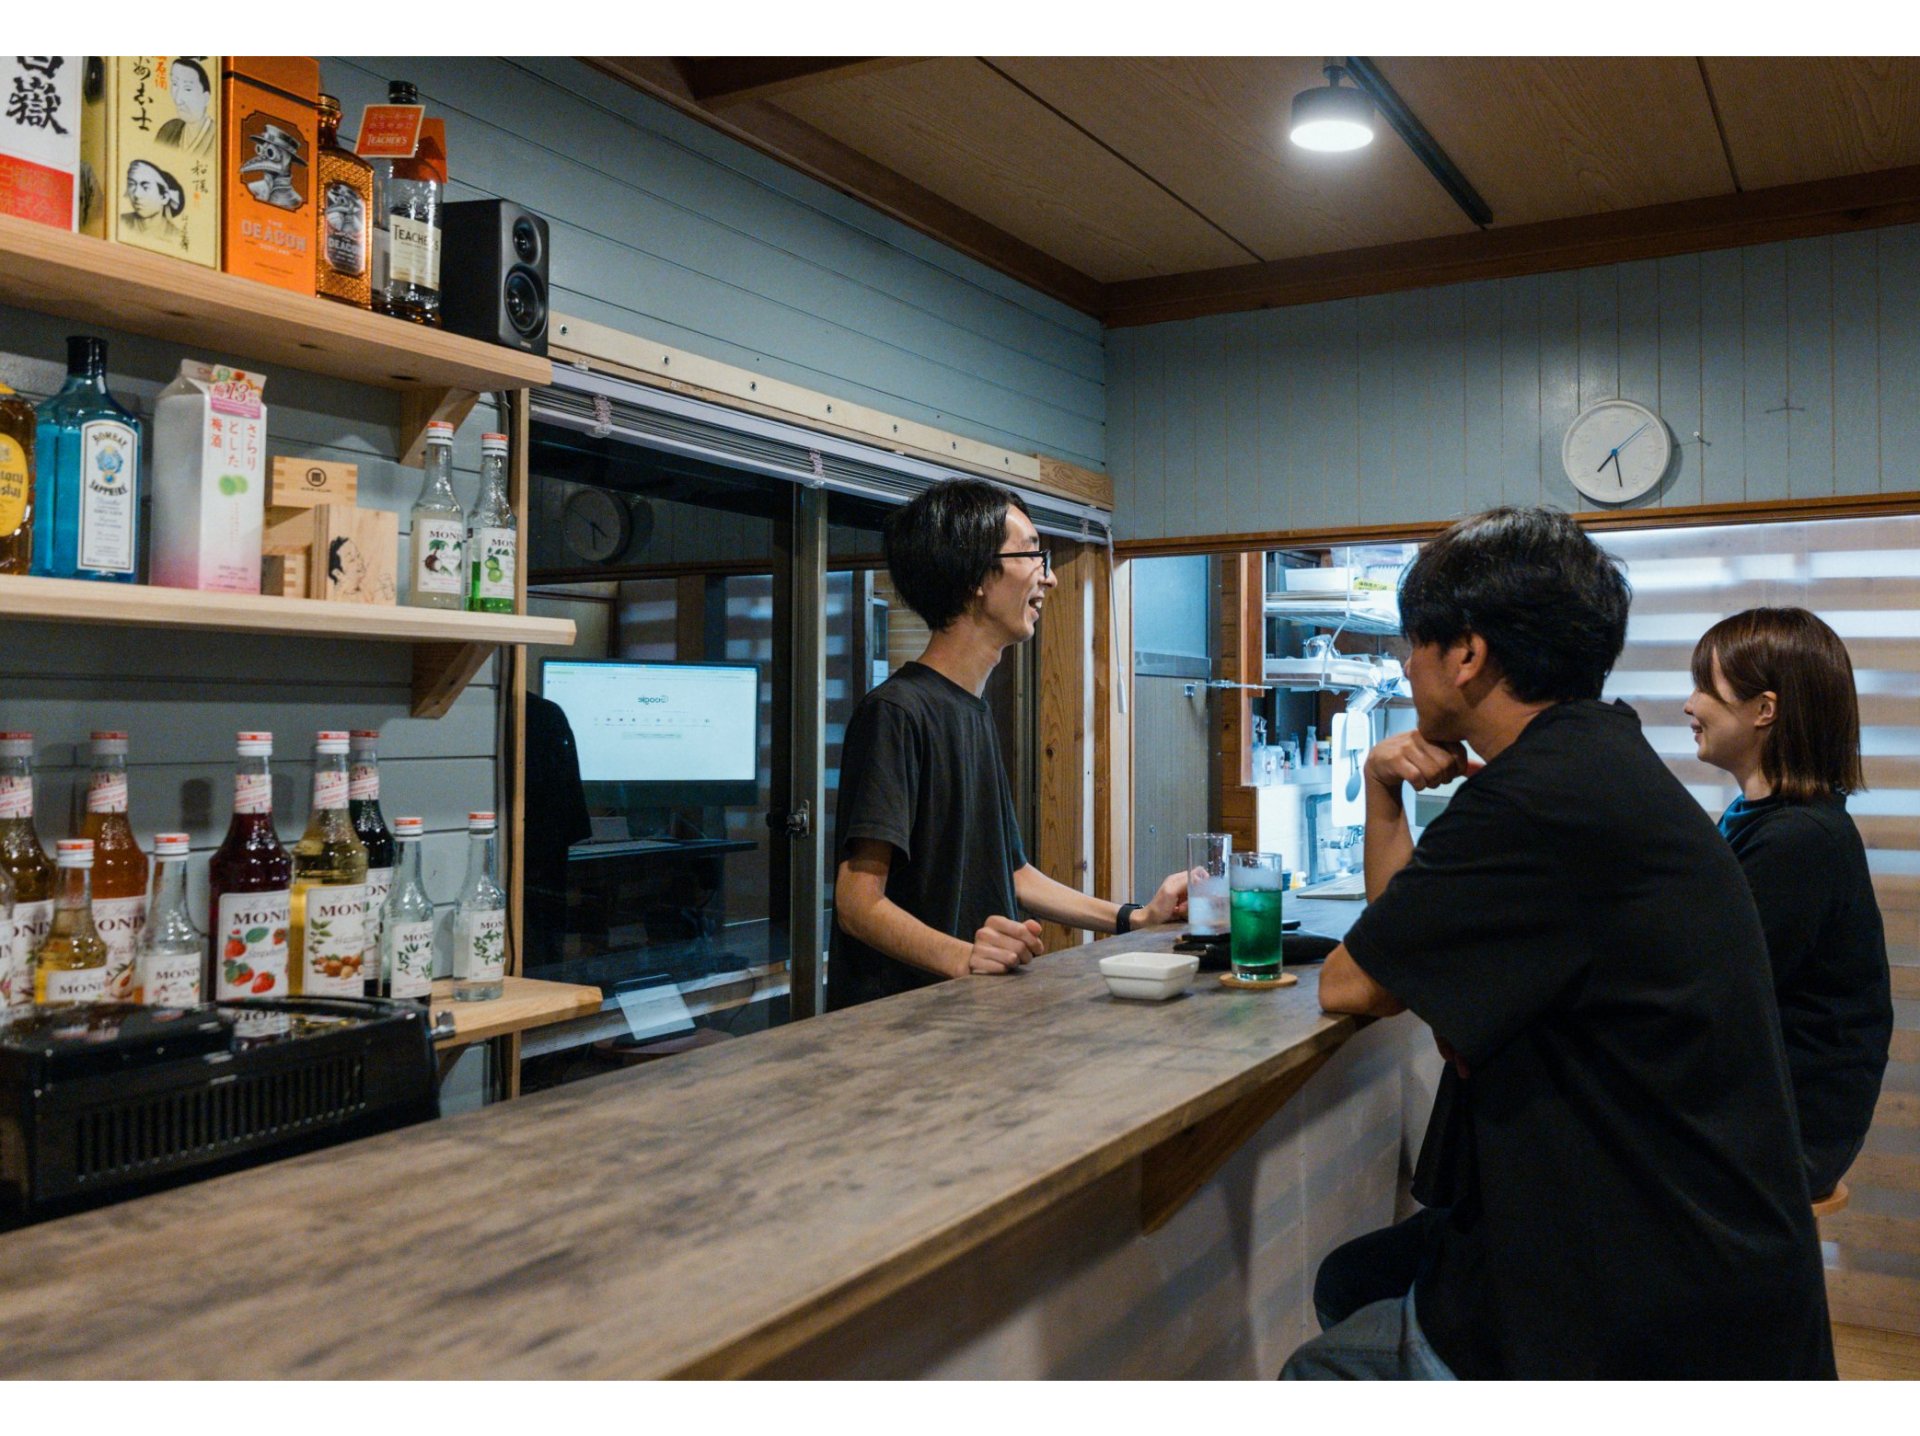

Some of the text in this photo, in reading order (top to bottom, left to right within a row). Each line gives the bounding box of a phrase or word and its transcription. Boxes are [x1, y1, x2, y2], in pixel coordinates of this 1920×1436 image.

[241, 218, 307, 252] DEACON
[92, 431, 128, 448] BOMBAY
[211, 416, 224, 449] 梅酒
[228, 420, 239, 468] とした
[247, 423, 258, 471] さらり
[89, 480, 128, 497] SAPPHIRE
